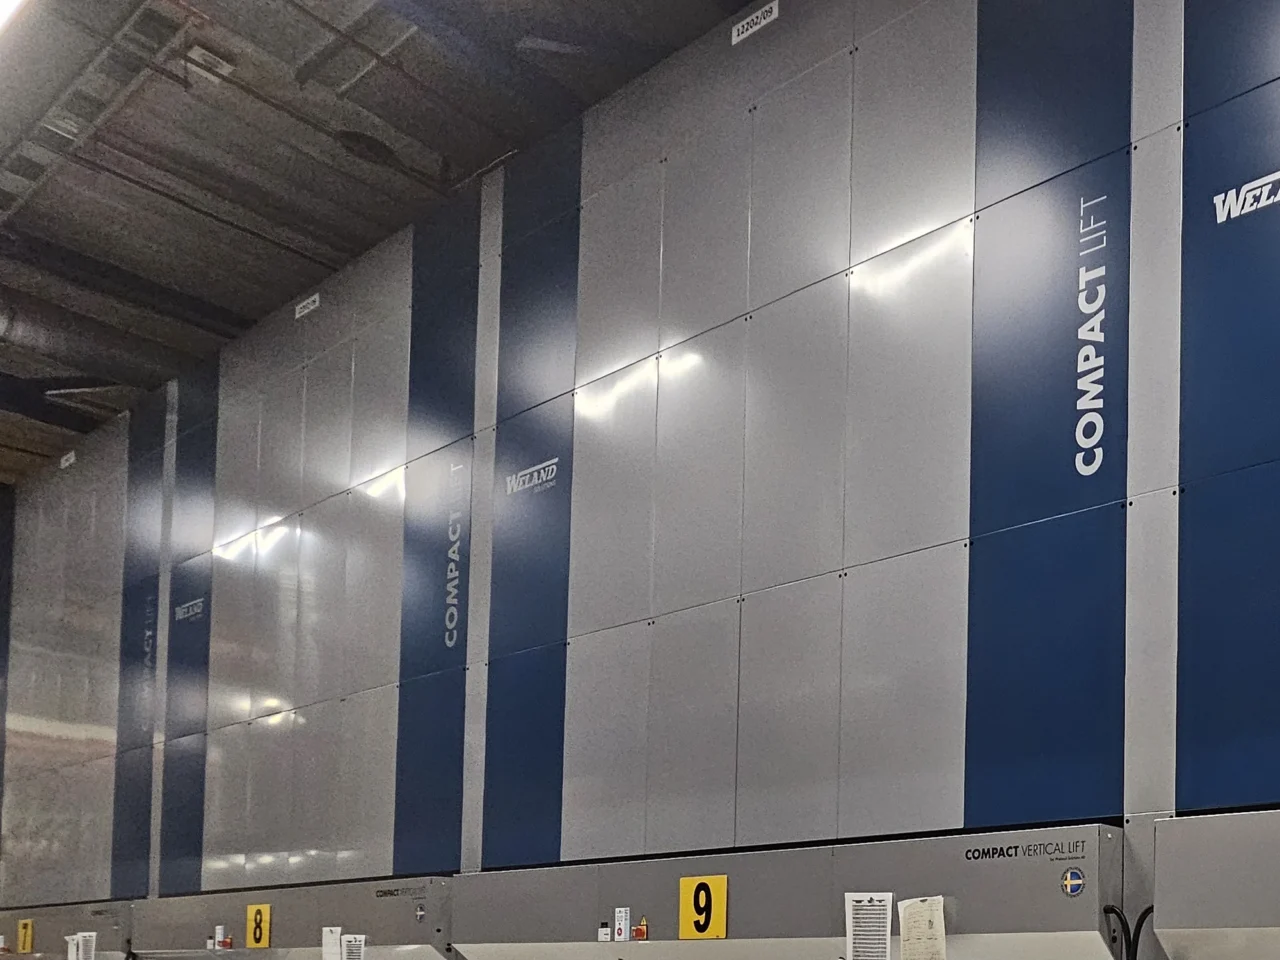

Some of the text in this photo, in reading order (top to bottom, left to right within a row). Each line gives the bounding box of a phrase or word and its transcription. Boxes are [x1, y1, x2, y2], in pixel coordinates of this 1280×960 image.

[736, 6, 774, 37] 12202/09
[1074, 195, 1107, 476] COMPACT LIFT
[505, 456, 559, 496] WELAND
[444, 511, 463, 648] COMPACT
[965, 840, 1086, 860] COMPACT VERTICAL LIFT
[253, 898, 263, 944] 8
[693, 881, 713, 934] 9
[22, 922, 29, 950] 7
